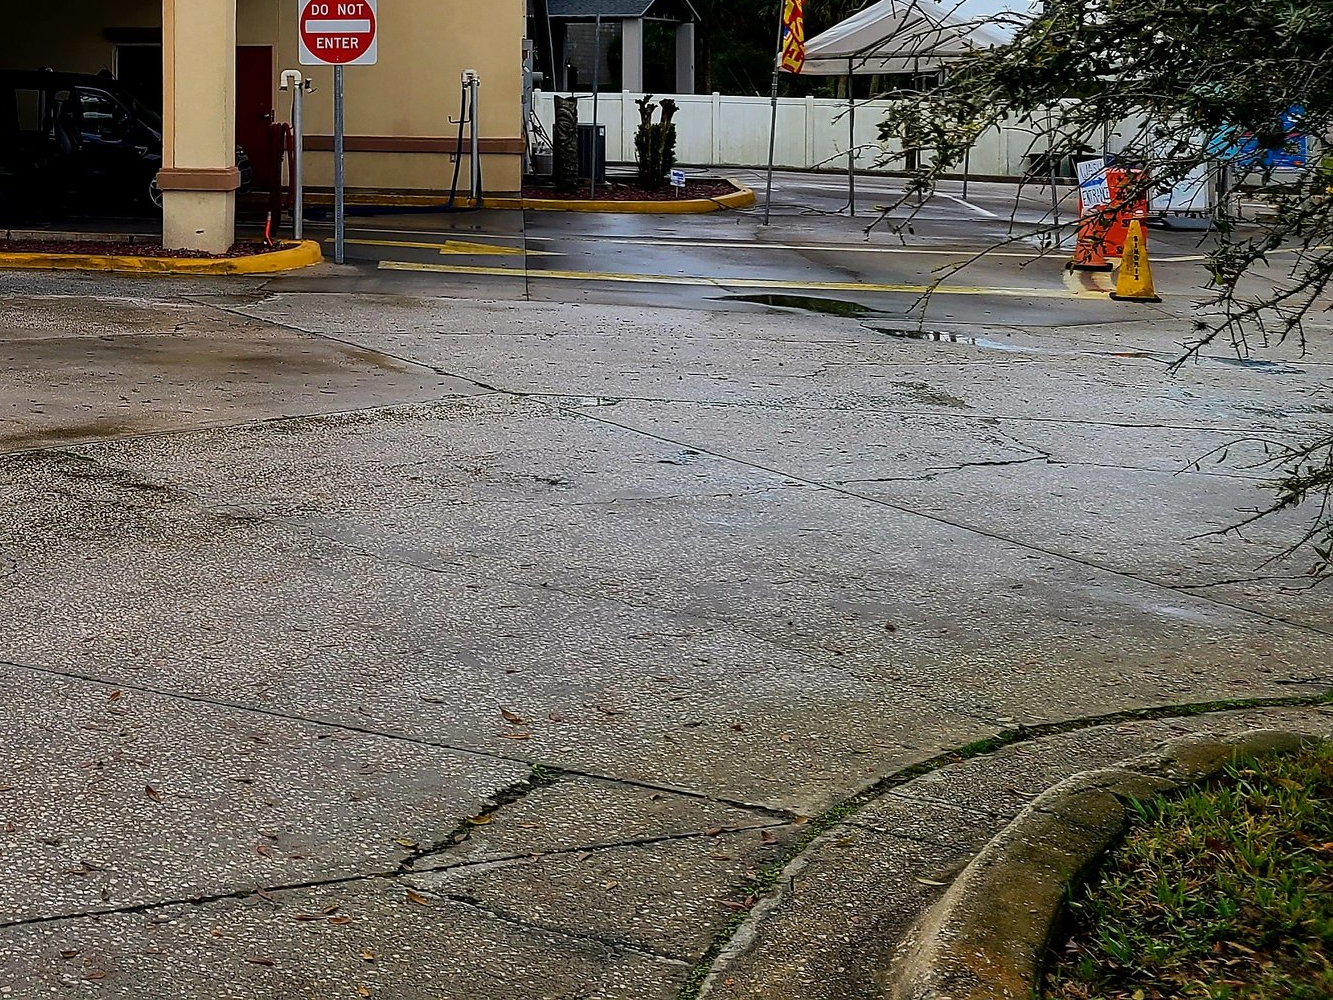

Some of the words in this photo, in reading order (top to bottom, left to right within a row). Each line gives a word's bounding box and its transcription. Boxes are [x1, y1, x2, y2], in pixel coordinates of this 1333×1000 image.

[311, 4, 329, 15] DO
[338, 4, 364, 15] NOT
[316, 37, 359, 49] ENTER
